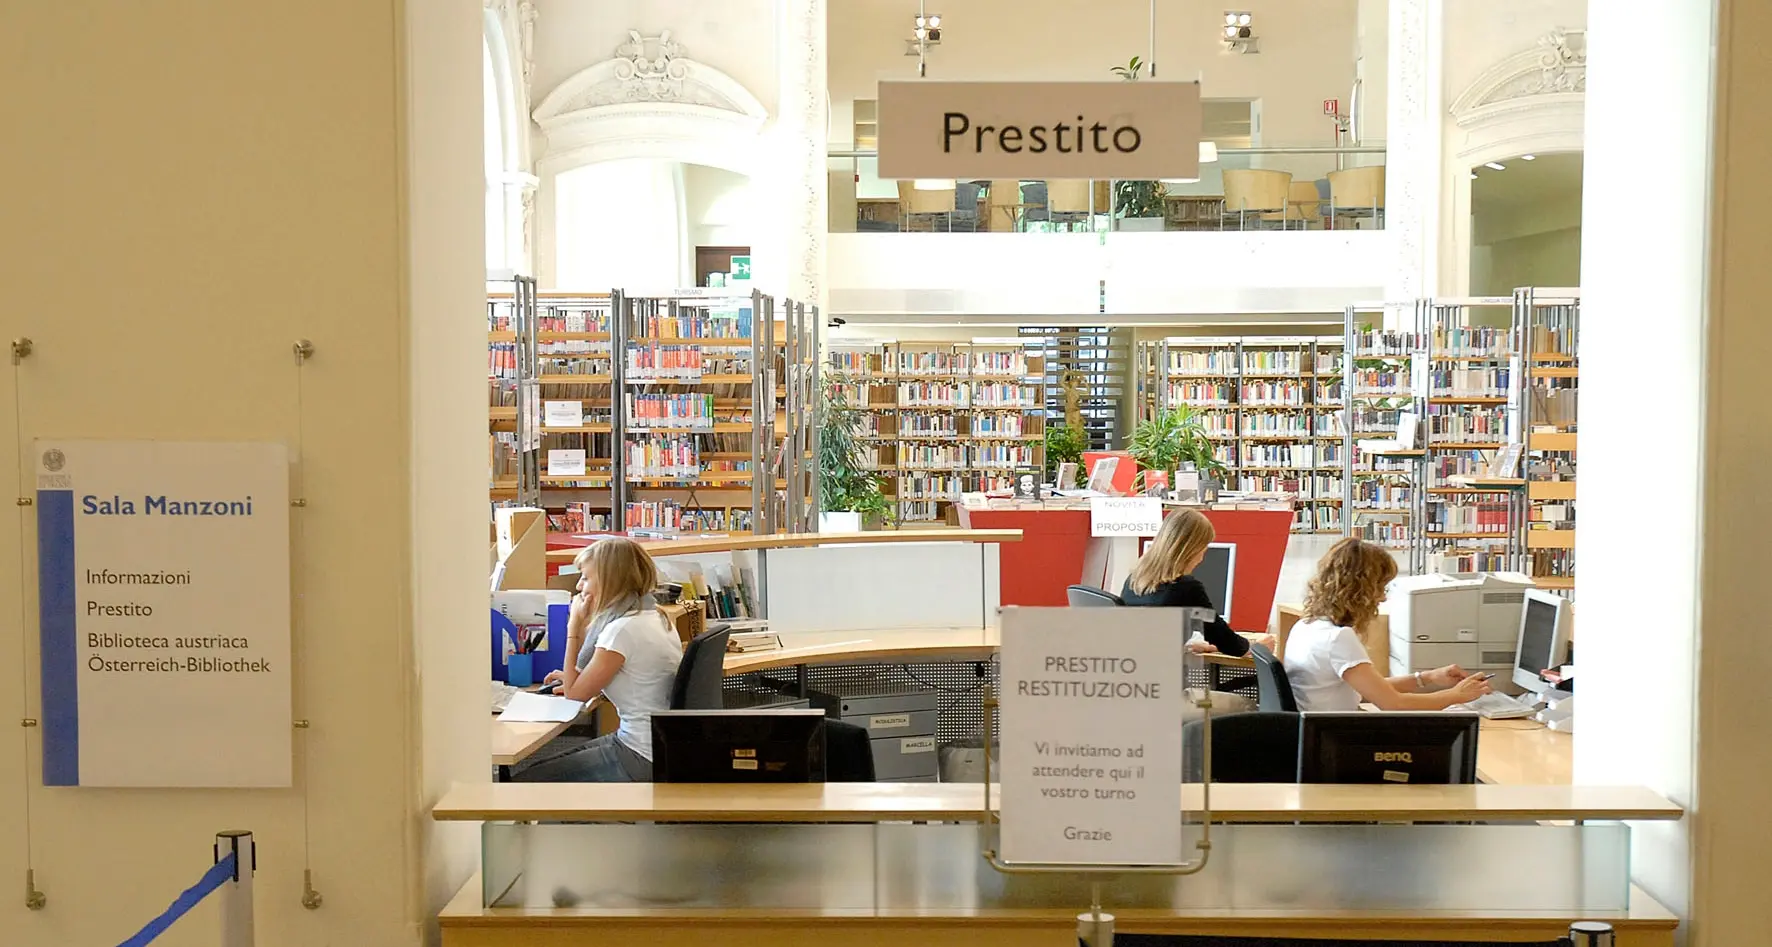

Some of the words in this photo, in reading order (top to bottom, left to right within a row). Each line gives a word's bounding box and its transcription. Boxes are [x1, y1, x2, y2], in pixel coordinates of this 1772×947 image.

[943, 112, 1142, 154] Prestito
[83, 495, 136, 516] Sala
[145, 495, 252, 516] Manzoni
[1096, 522, 1157, 532] PROPOSTE
[86, 569, 191, 585] Informazioni
[87, 601, 153, 617] Prestito
[88, 633, 169, 649] Biblioteca
[175, 634, 248, 649] austriaca
[88, 653, 271, 673] Österreich-Bibliothek
[1045, 657, 1137, 674] PRESTITO
[1018, 681, 1160, 699] RESTITUZIONE
[1034, 742, 1049, 755] Vi
[1055, 743, 1121, 758] invitiamo
[1127, 744, 1143, 758] ad
[1374, 752, 1412, 763] BenQ
[1032, 764, 1104, 778] attendere
[1110, 766, 1131, 781] qui
[1137, 766, 1144, 778] il
[1041, 787, 1088, 798] vostro
[1095, 788, 1135, 799] turno
[1064, 827, 1112, 841] Grazie
